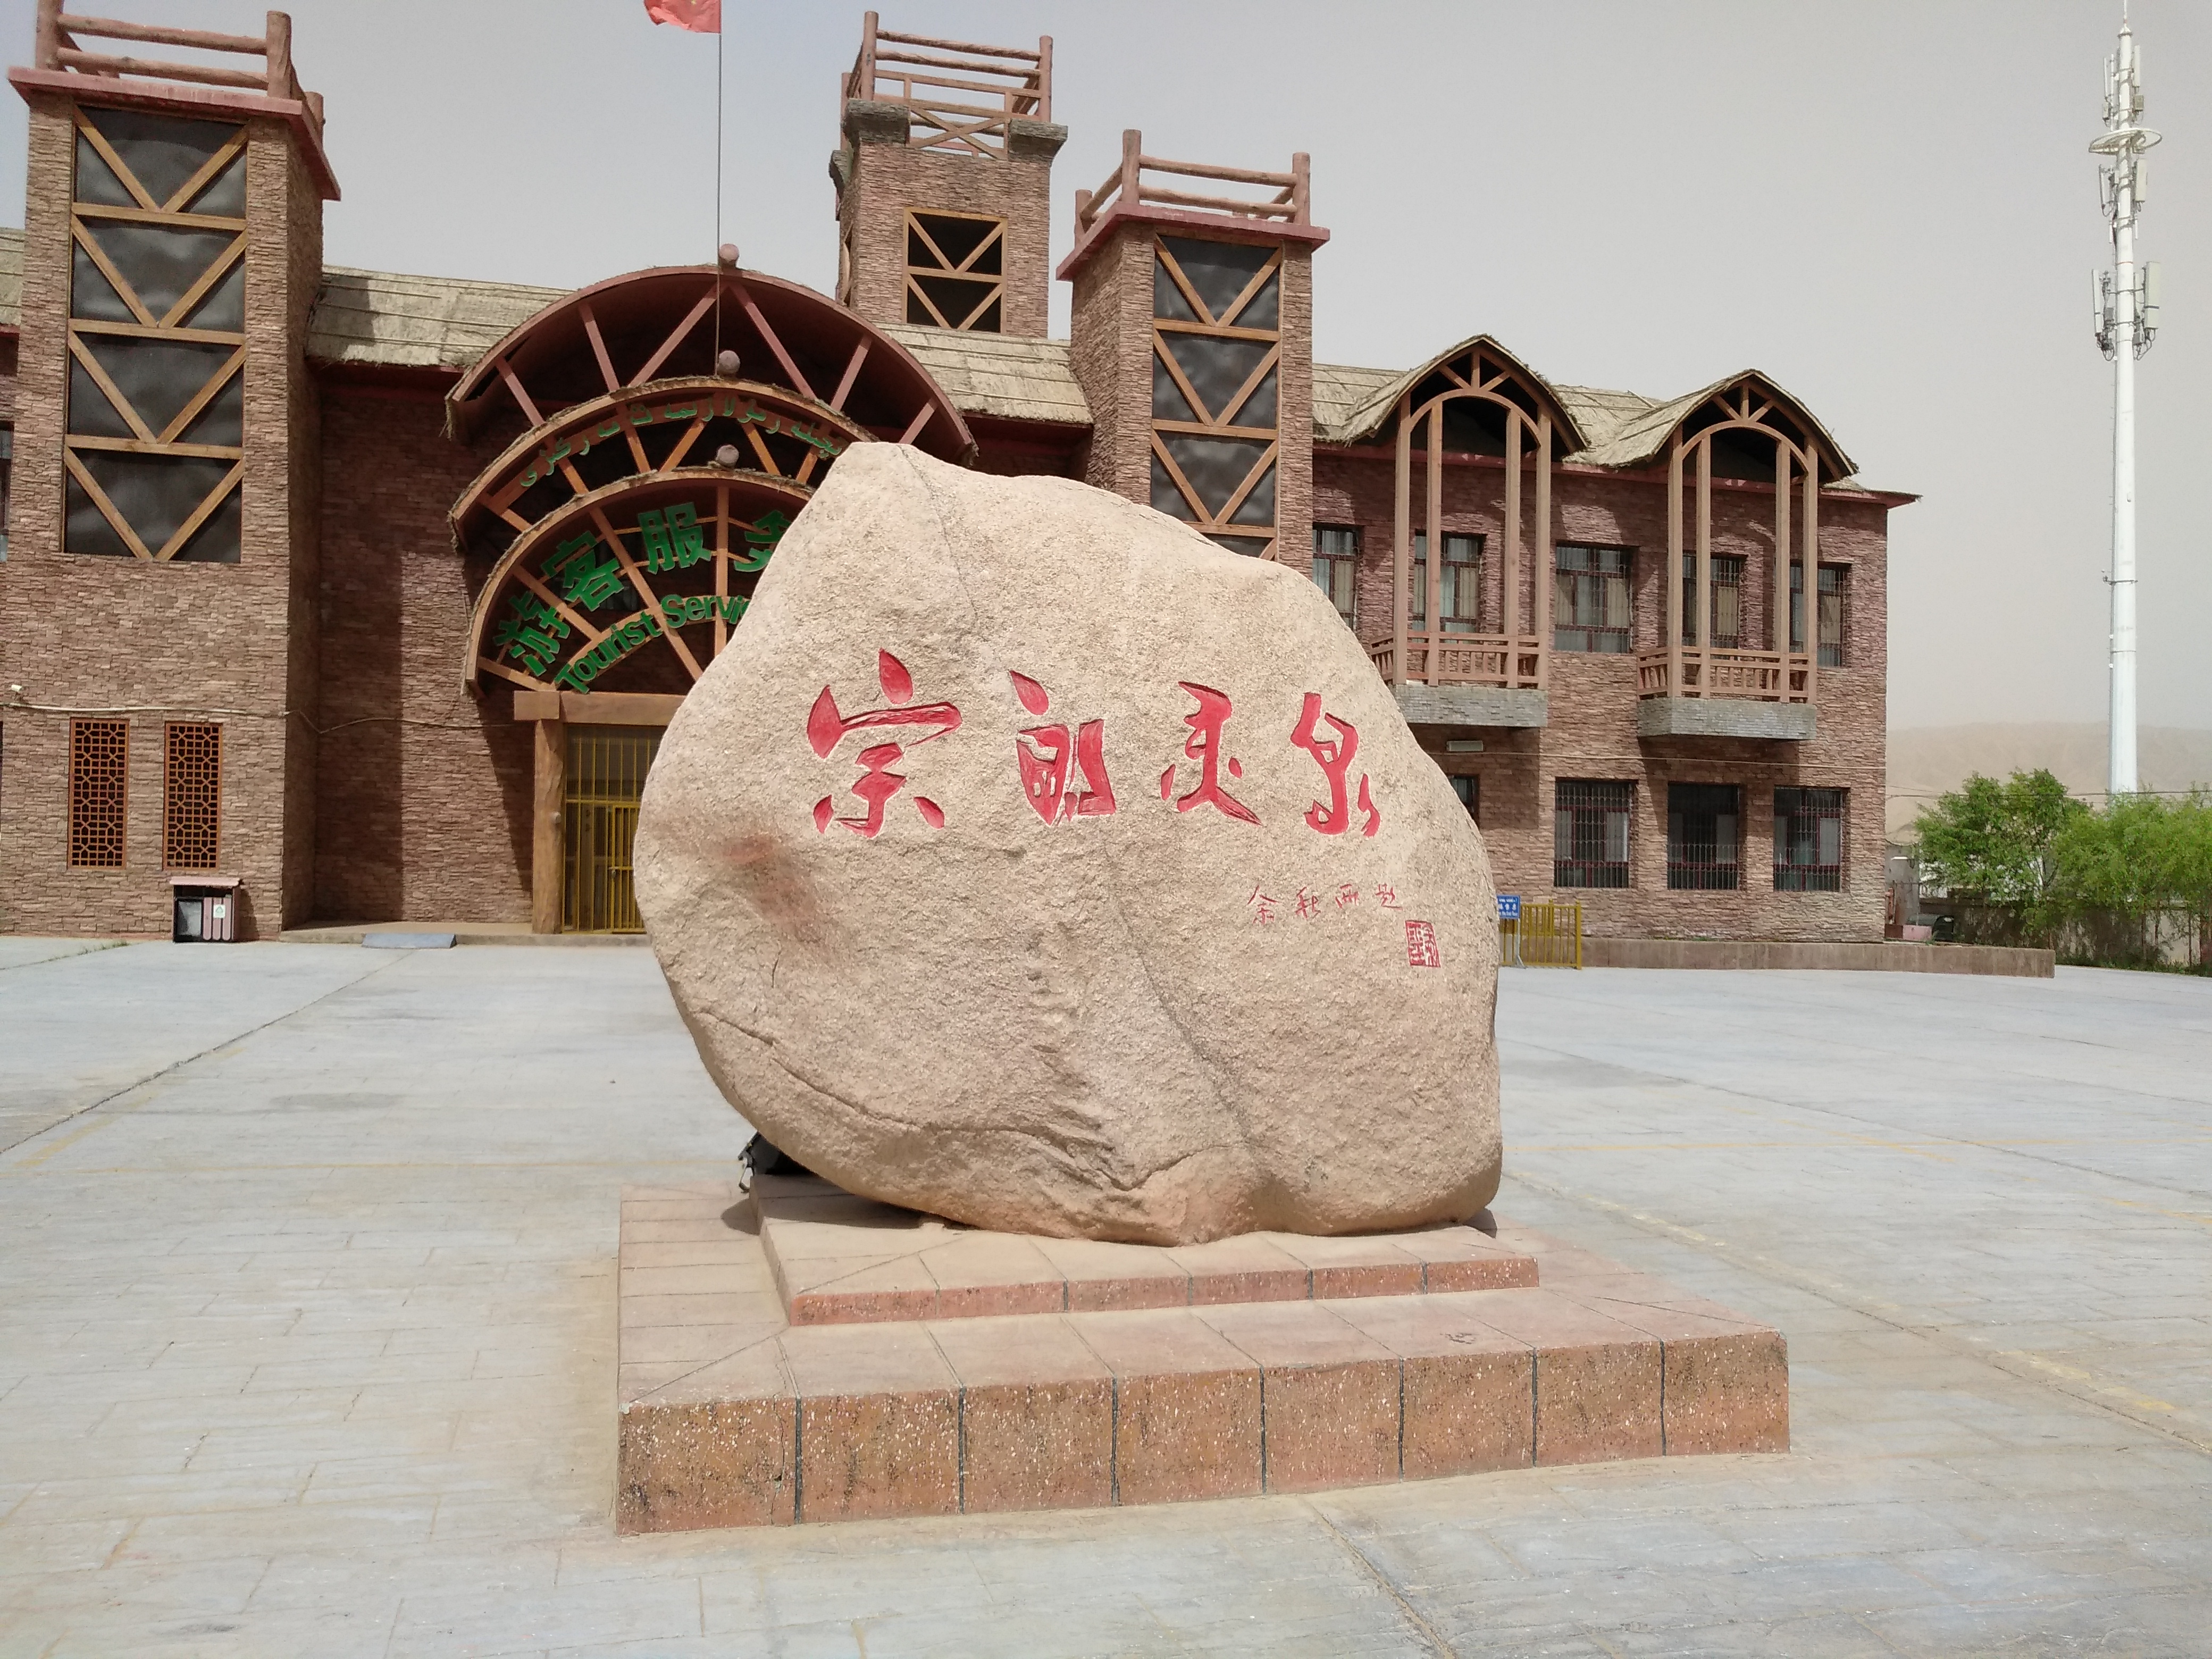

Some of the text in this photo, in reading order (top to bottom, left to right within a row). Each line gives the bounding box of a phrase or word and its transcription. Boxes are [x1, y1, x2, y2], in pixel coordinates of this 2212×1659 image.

[493, 501, 792, 677] 游客服务
[554, 609, 663, 695] Tourist
